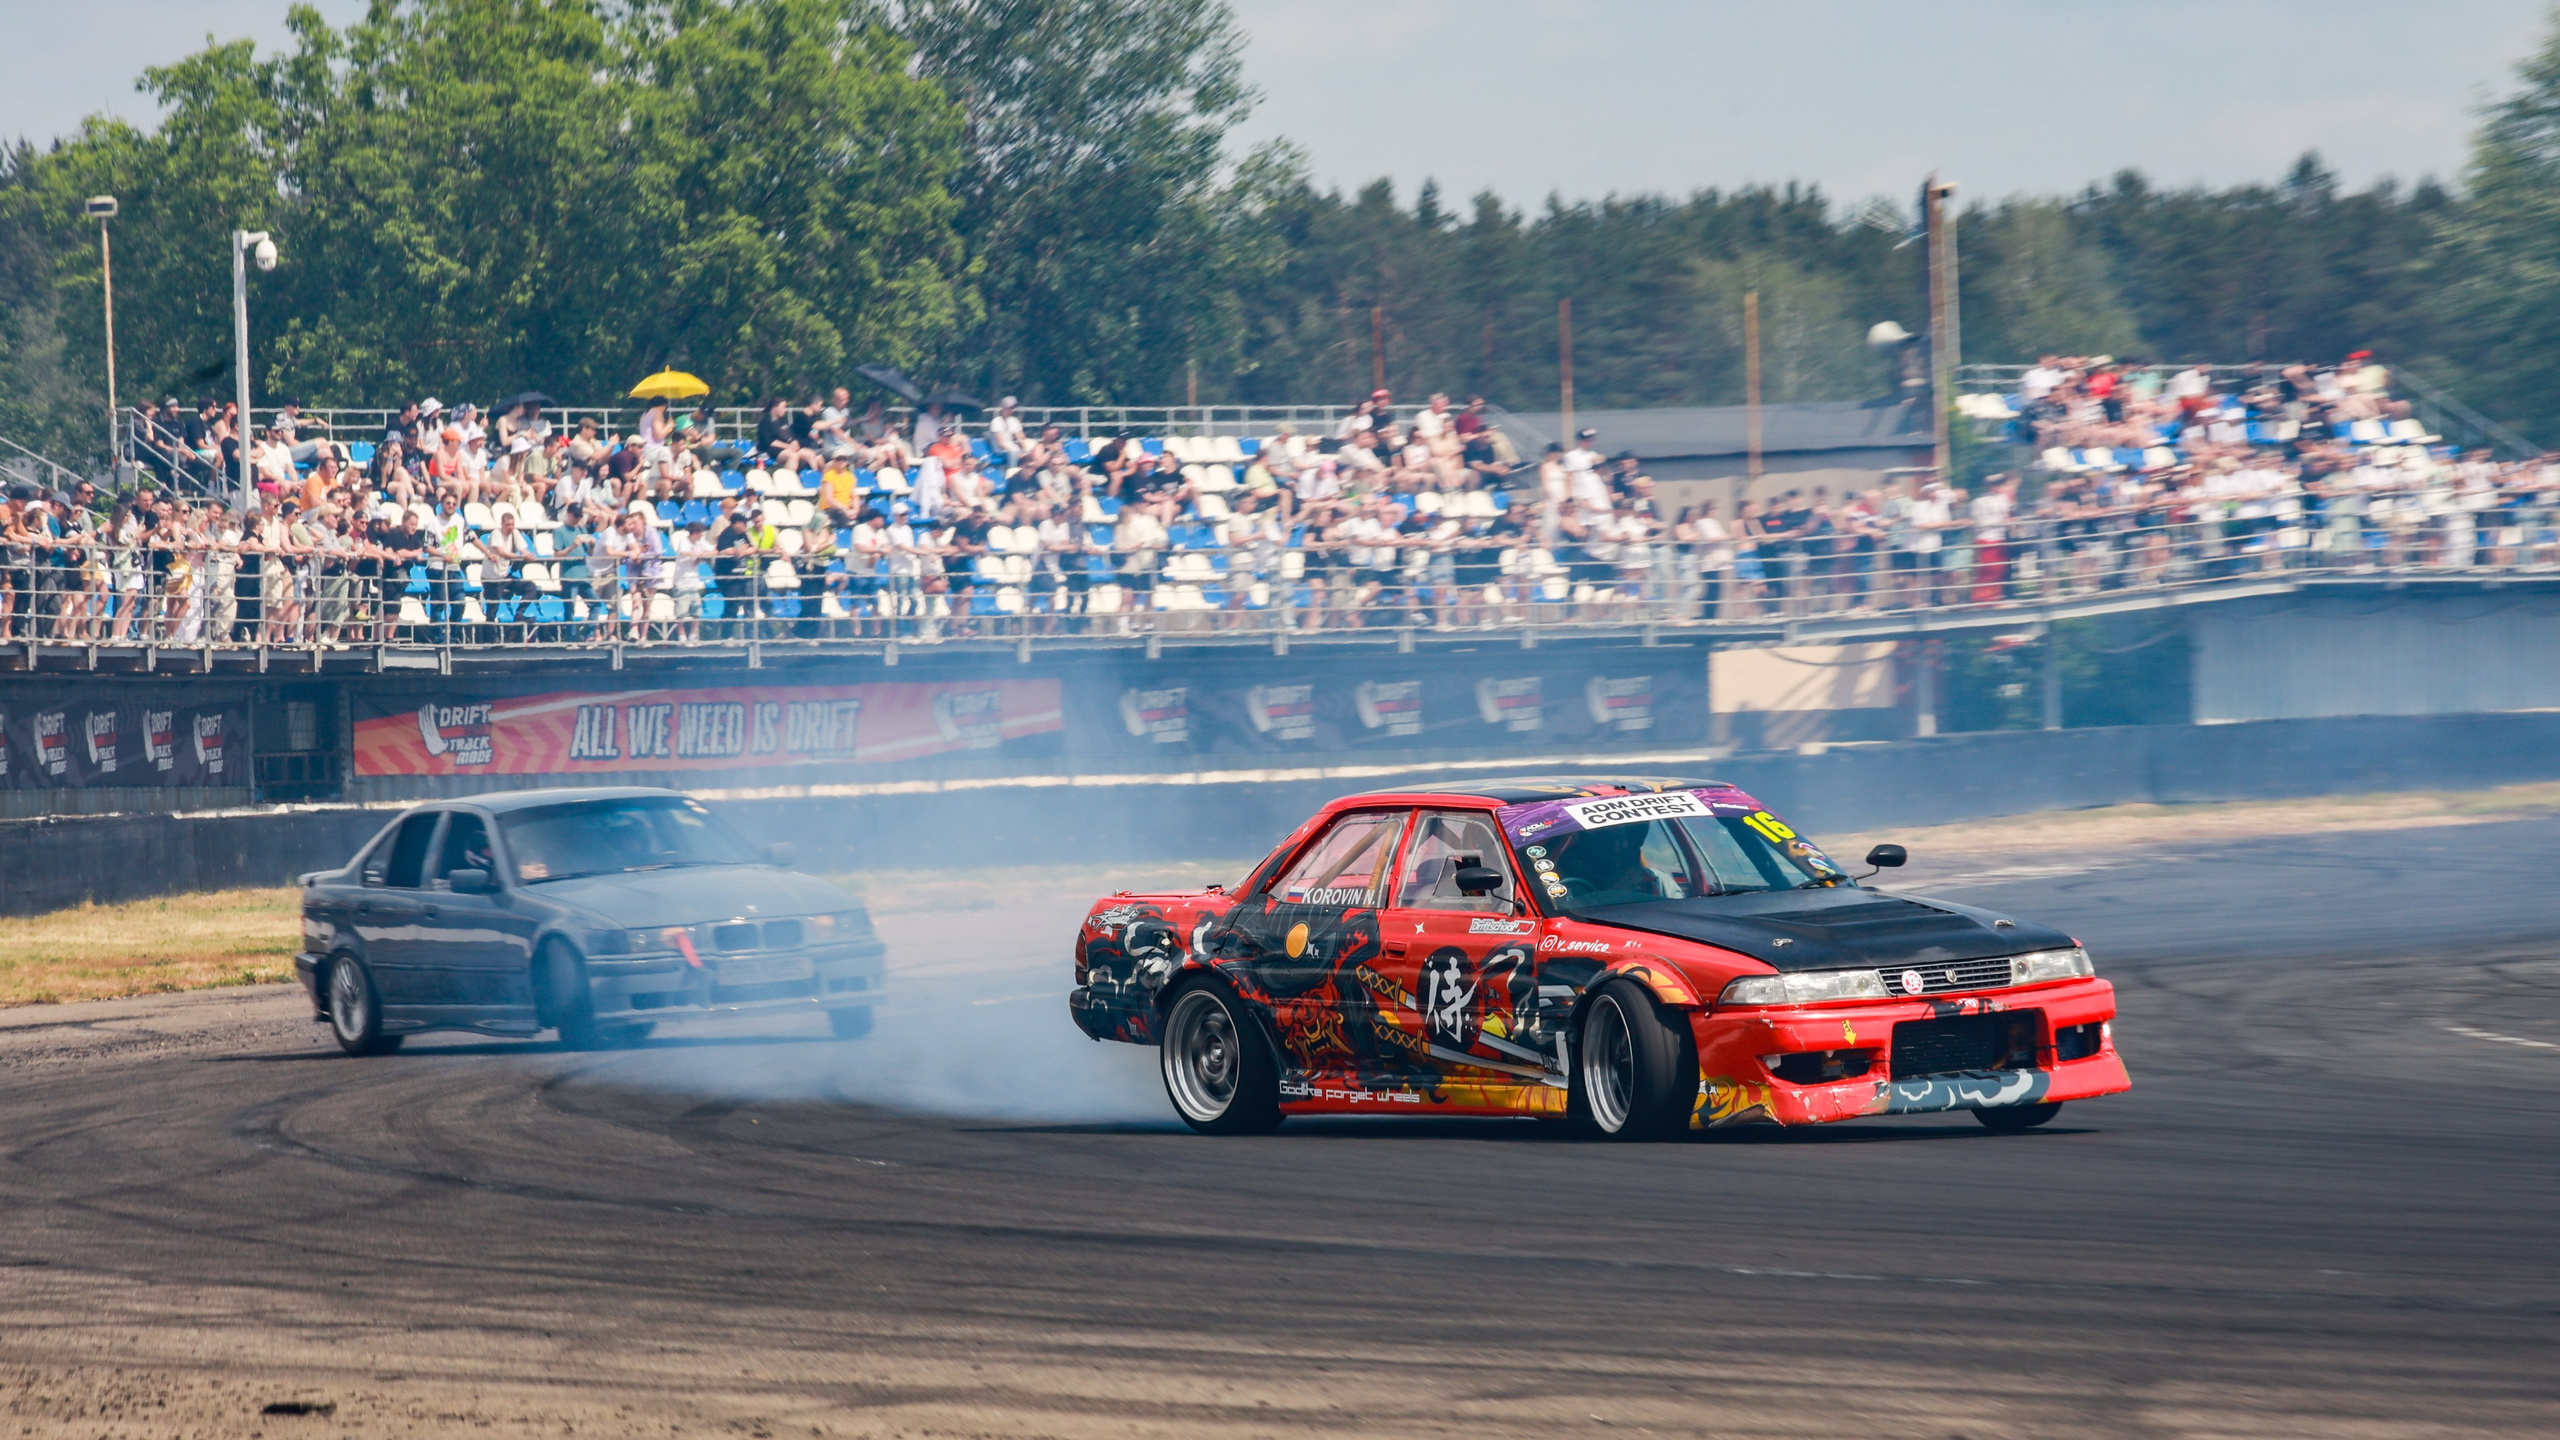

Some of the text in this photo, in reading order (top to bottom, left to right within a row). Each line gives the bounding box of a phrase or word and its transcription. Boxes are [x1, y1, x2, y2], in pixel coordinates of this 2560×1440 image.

[201, 714, 222, 736] DRIFT
[439, 705, 492, 727] DRIFT
[570, 699, 860, 757] ALL WE NEED IS DRIFT
[450, 736, 490, 752] TRACK
[455, 749, 493, 765] MODE
[1581, 795, 1687, 815] ADM DRIFT
[1588, 803, 1696, 824] CONTEST
[1742, 811, 1797, 844] 16
[1301, 887, 1376, 905] KOROVIN N.
[1279, 1079, 1420, 1103] Godlike forget wheels
